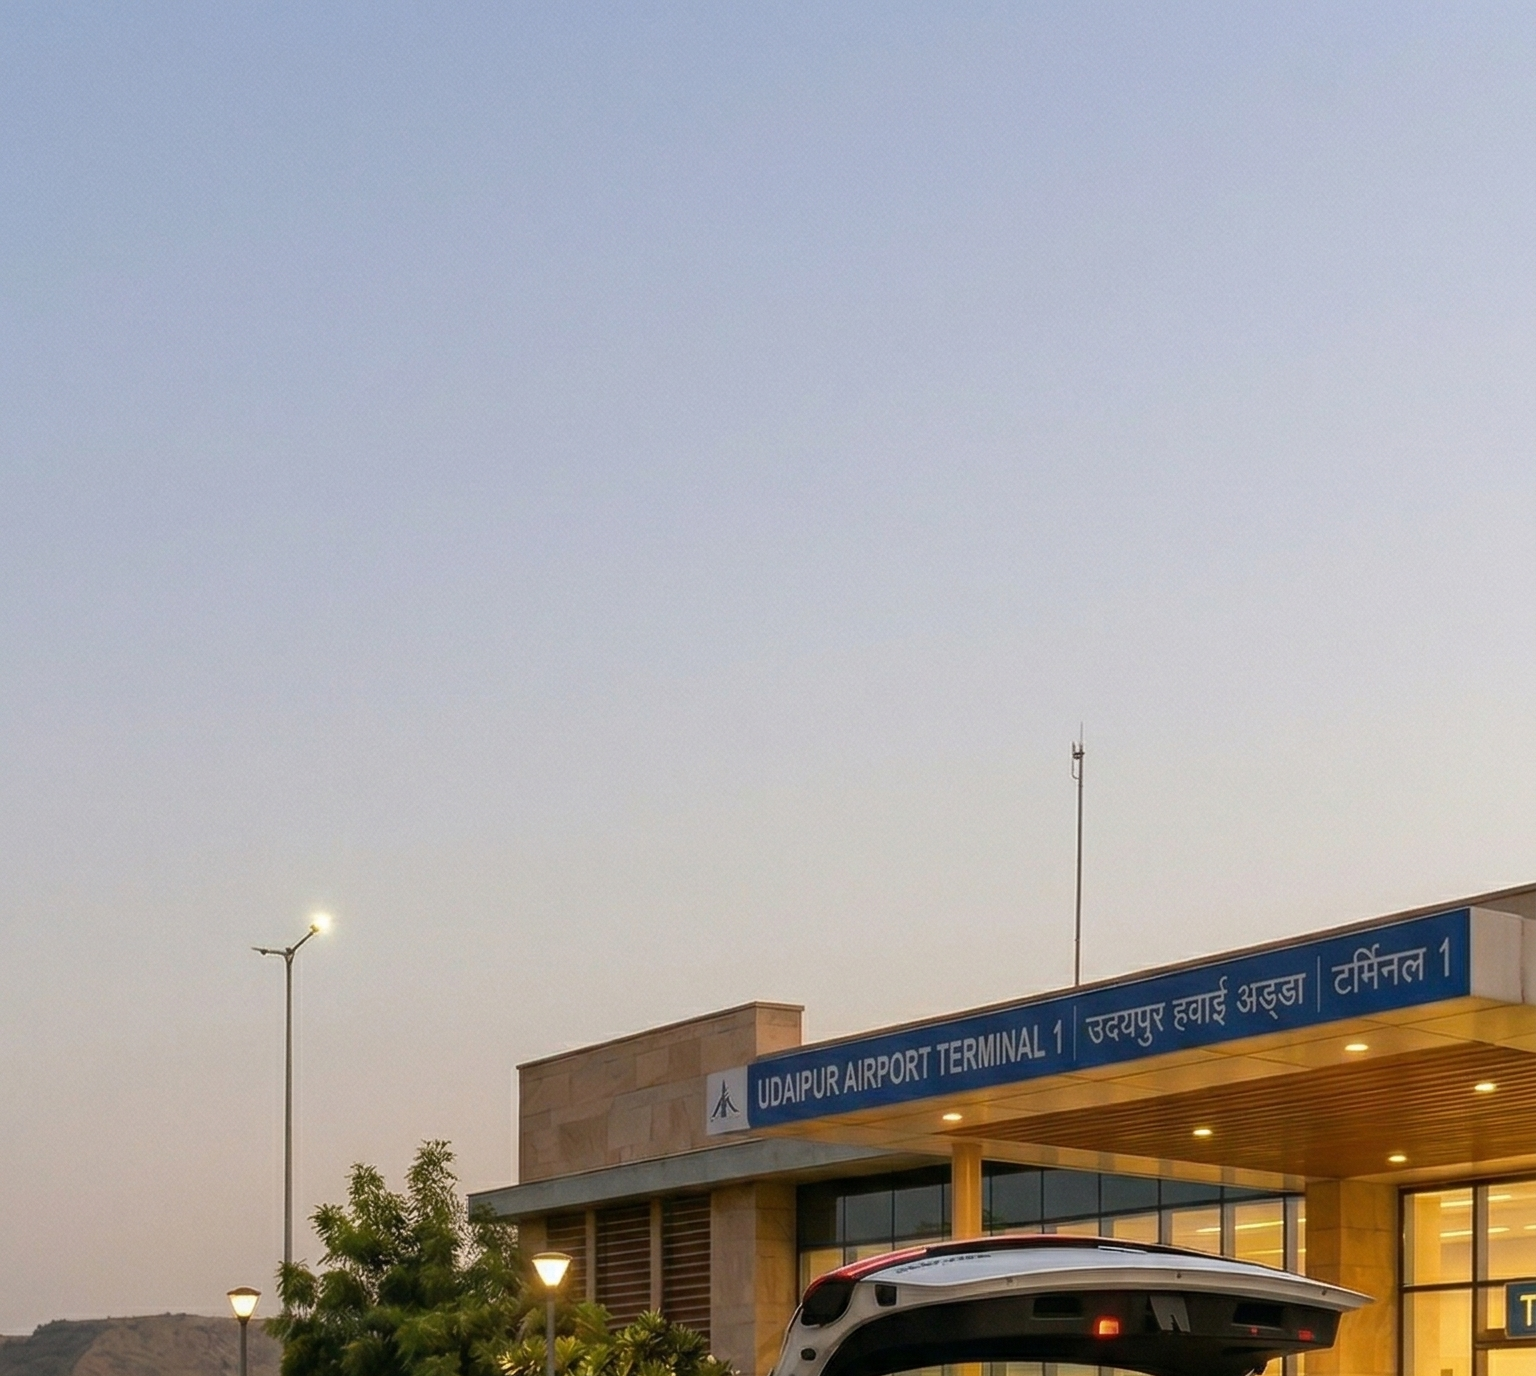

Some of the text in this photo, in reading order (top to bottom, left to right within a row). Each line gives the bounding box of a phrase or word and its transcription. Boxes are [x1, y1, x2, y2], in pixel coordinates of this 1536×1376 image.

[1085, 1002, 1166, 1047] उदयपुर
[1172, 976, 1228, 1031] हवाई
[1331, 943, 1427, 995] टर्मिनल
[1439, 937, 1450, 978] 1
[758, 1019, 1062, 1110] UDAIPUR AIRPORT TERMINAL 1
